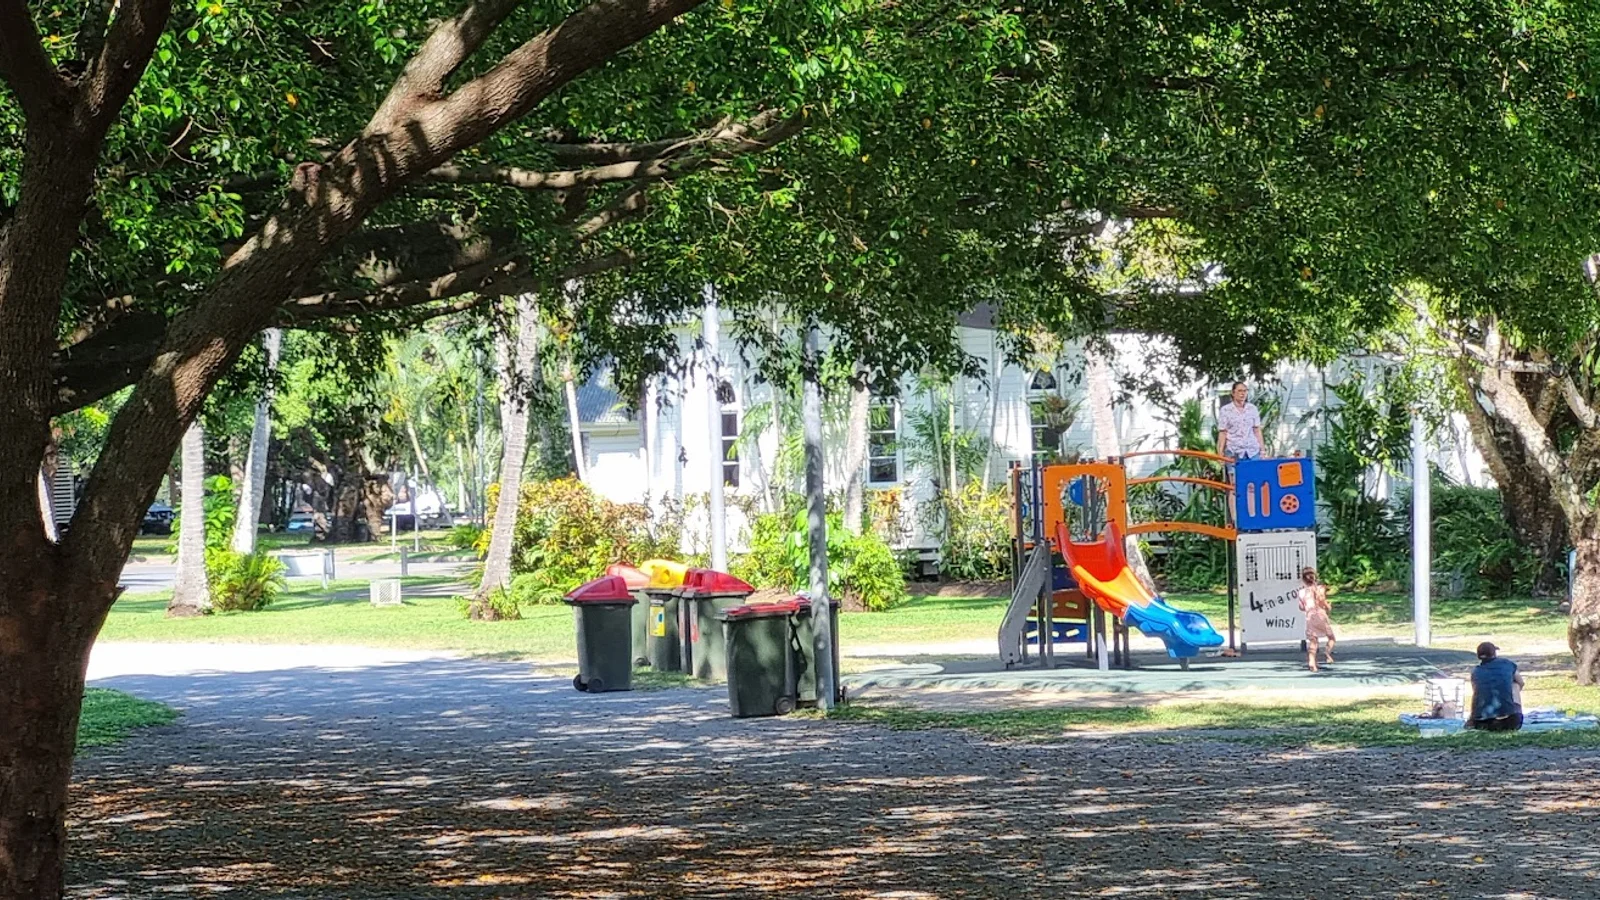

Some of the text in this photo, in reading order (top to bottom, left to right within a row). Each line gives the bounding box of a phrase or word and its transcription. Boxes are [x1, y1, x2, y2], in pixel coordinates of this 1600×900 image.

[1250, 585, 1305, 613] 4 in a ro
[1265, 616, 1295, 628] wins!
